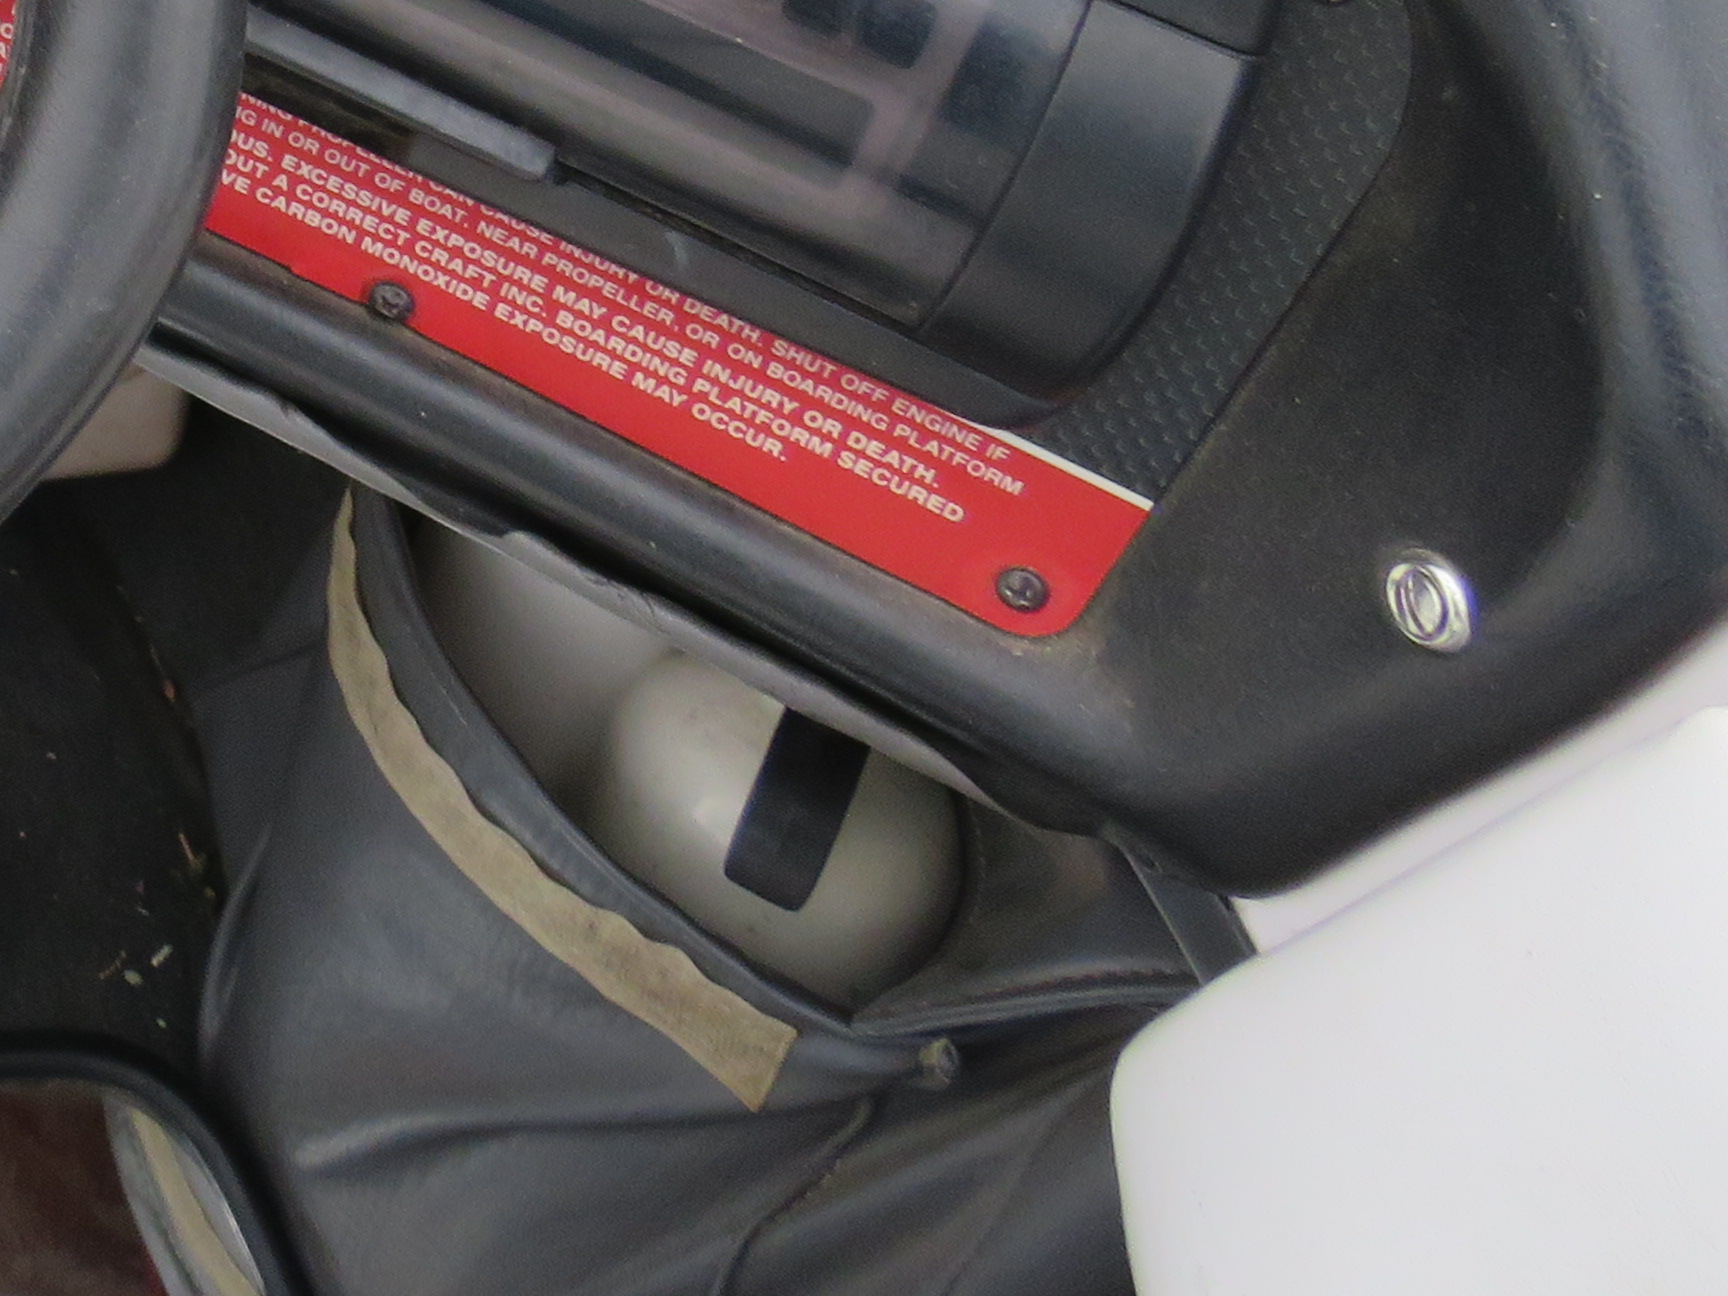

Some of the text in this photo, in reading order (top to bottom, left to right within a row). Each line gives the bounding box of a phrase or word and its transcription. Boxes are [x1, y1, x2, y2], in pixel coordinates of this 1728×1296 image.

[255, 187, 785, 461] CARBON MONOXIDE EXPOSURE MAY OCCUR.
[261, 118, 284, 138] IN
[288, 131, 320, 155] OR
[324, 148, 370, 177] OUT
[374, 172, 405, 192] OF
[476, 220, 538, 259] NEAR
[541, 252, 678, 331] PROPELLER,
[685, 323, 720, 348] OR
[727, 343, 762, 368] ON
[766, 361, 889, 430] BOARDING
[892, 423, 1024, 495] PLATFORM
[271, 173, 963, 521] A CORRECT CRAFT INC. BOARDING PLATFORM SECURED
[281, 154, 411, 225] EXCESSIVE
[415, 218, 548, 292] EXPOSURE
[552, 285, 607, 319] MAY
[611, 315, 698, 367] CAUSE
[702, 359, 799, 414] INJURY
[803, 410, 842, 439] OR
[846, 430, 938, 487] DEATH.
[682, 297, 762, 346] DEATH.
[770, 339, 837, 378] SHUT
[840, 373, 889, 401] OFF
[891, 397, 982, 450] ENGINE
[985, 443, 1010, 459] IF
